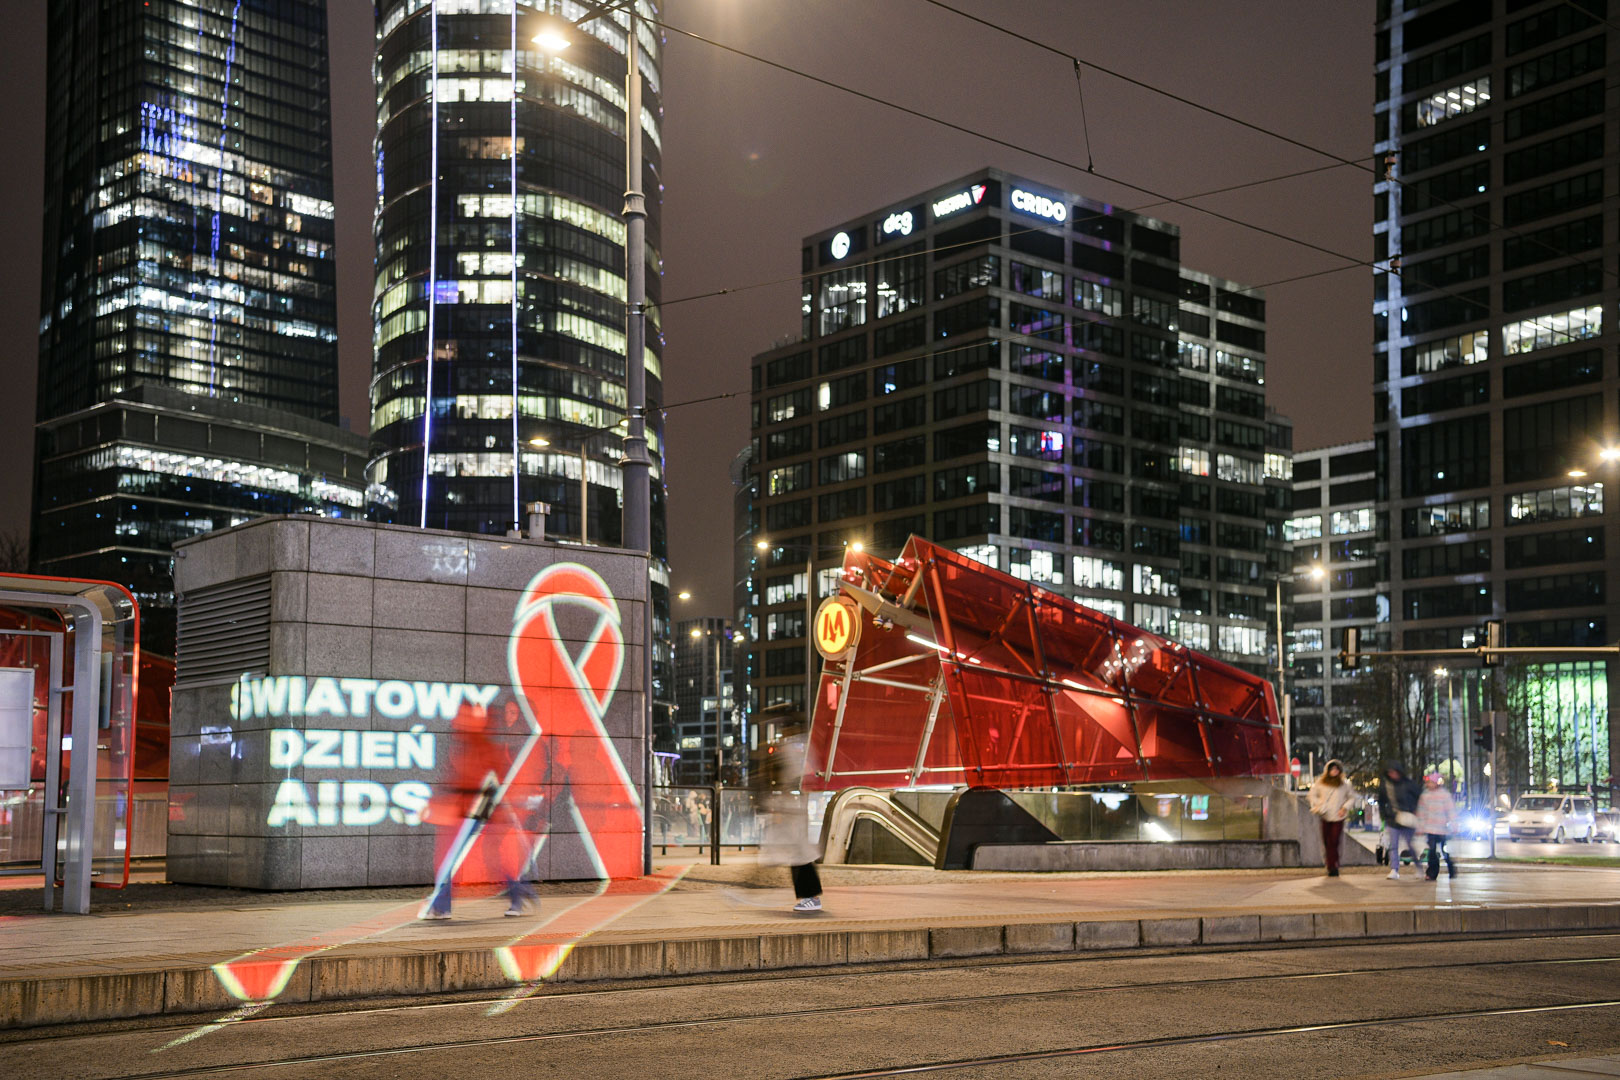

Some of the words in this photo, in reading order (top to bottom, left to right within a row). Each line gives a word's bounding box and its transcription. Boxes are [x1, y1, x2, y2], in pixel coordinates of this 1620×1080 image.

[1011, 189, 1067, 222] CRIDO
[883, 211, 913, 236] dcg
[1094, 527, 1122, 551] dcg
[823, 610, 845, 643] M
[230, 672, 500, 721] ŚWIATOWY
[269, 724, 436, 770] DZIEŃ
[266, 778, 433, 828] AIDS
